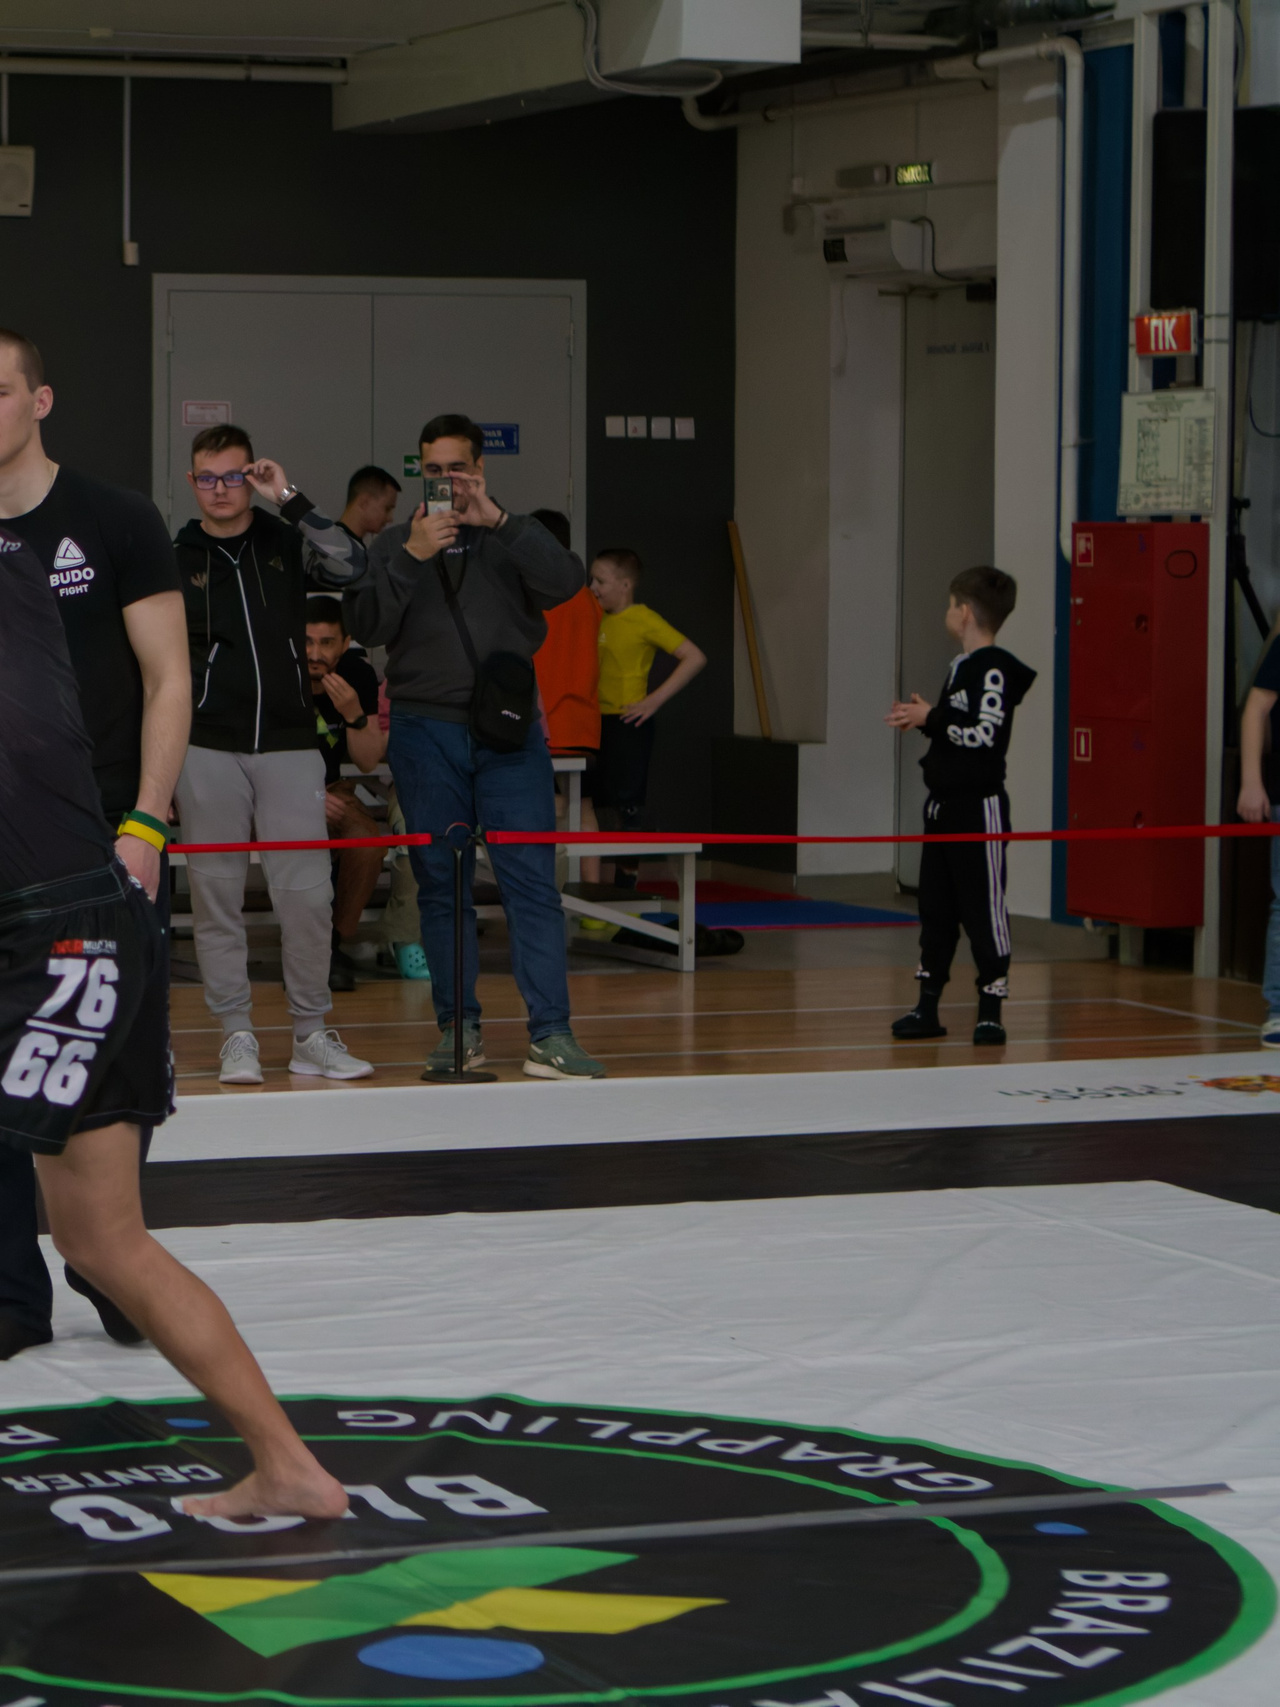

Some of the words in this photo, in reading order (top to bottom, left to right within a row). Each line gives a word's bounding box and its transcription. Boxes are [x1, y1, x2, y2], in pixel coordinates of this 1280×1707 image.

[1150, 317, 1178, 351] ПК
[49, 567, 95, 588] BUDO
[59, 584, 90, 598] FIGHT
[946, 667, 1006, 749] adidas
[31, 956, 120, 1030] 76
[0, 1030, 98, 1106] 66
[1, 1463, 224, 1493] CENTER
[336, 1408, 995, 1492] GRAPPLING
[712, 1569, 1171, 1707] BRAZILIA
